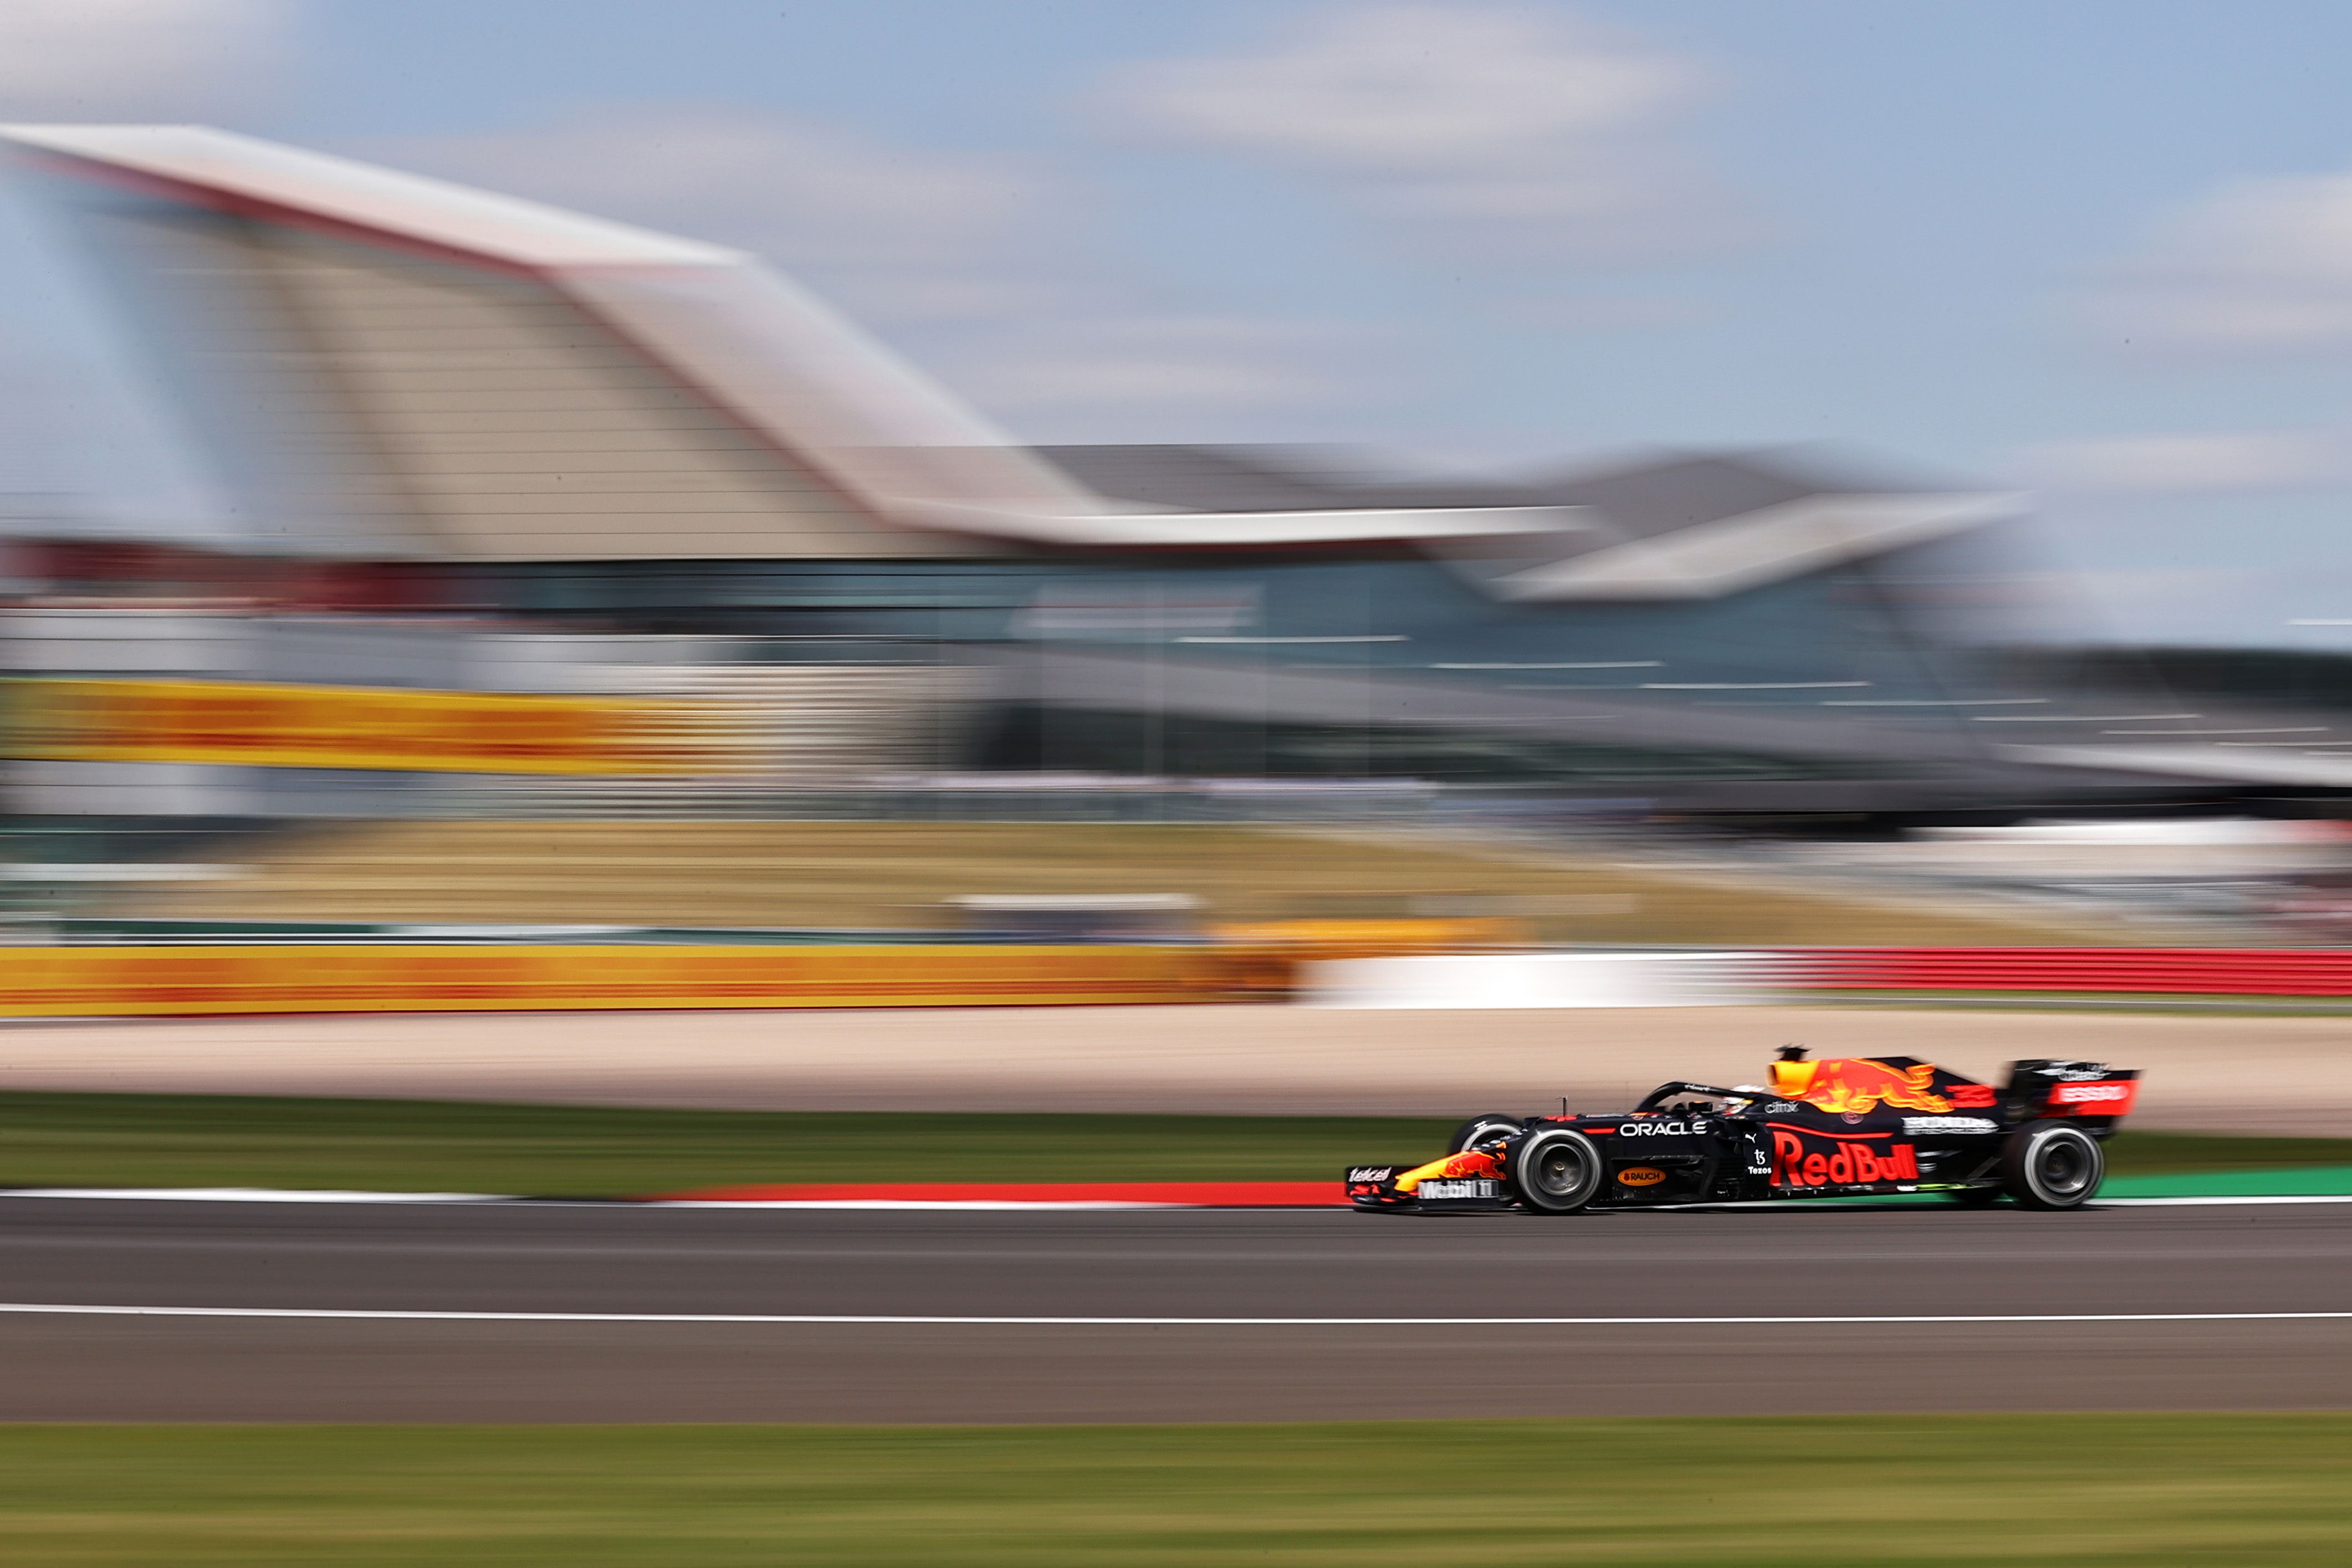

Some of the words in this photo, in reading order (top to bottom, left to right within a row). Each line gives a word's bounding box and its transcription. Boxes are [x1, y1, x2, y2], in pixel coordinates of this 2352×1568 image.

[1620, 1121, 1707, 1136] ORACLE
[1348, 1167, 1392, 1182] telcel
[1630, 1172, 1660, 1181] RAUCH
[1748, 1166, 1772, 1175] Tezos
